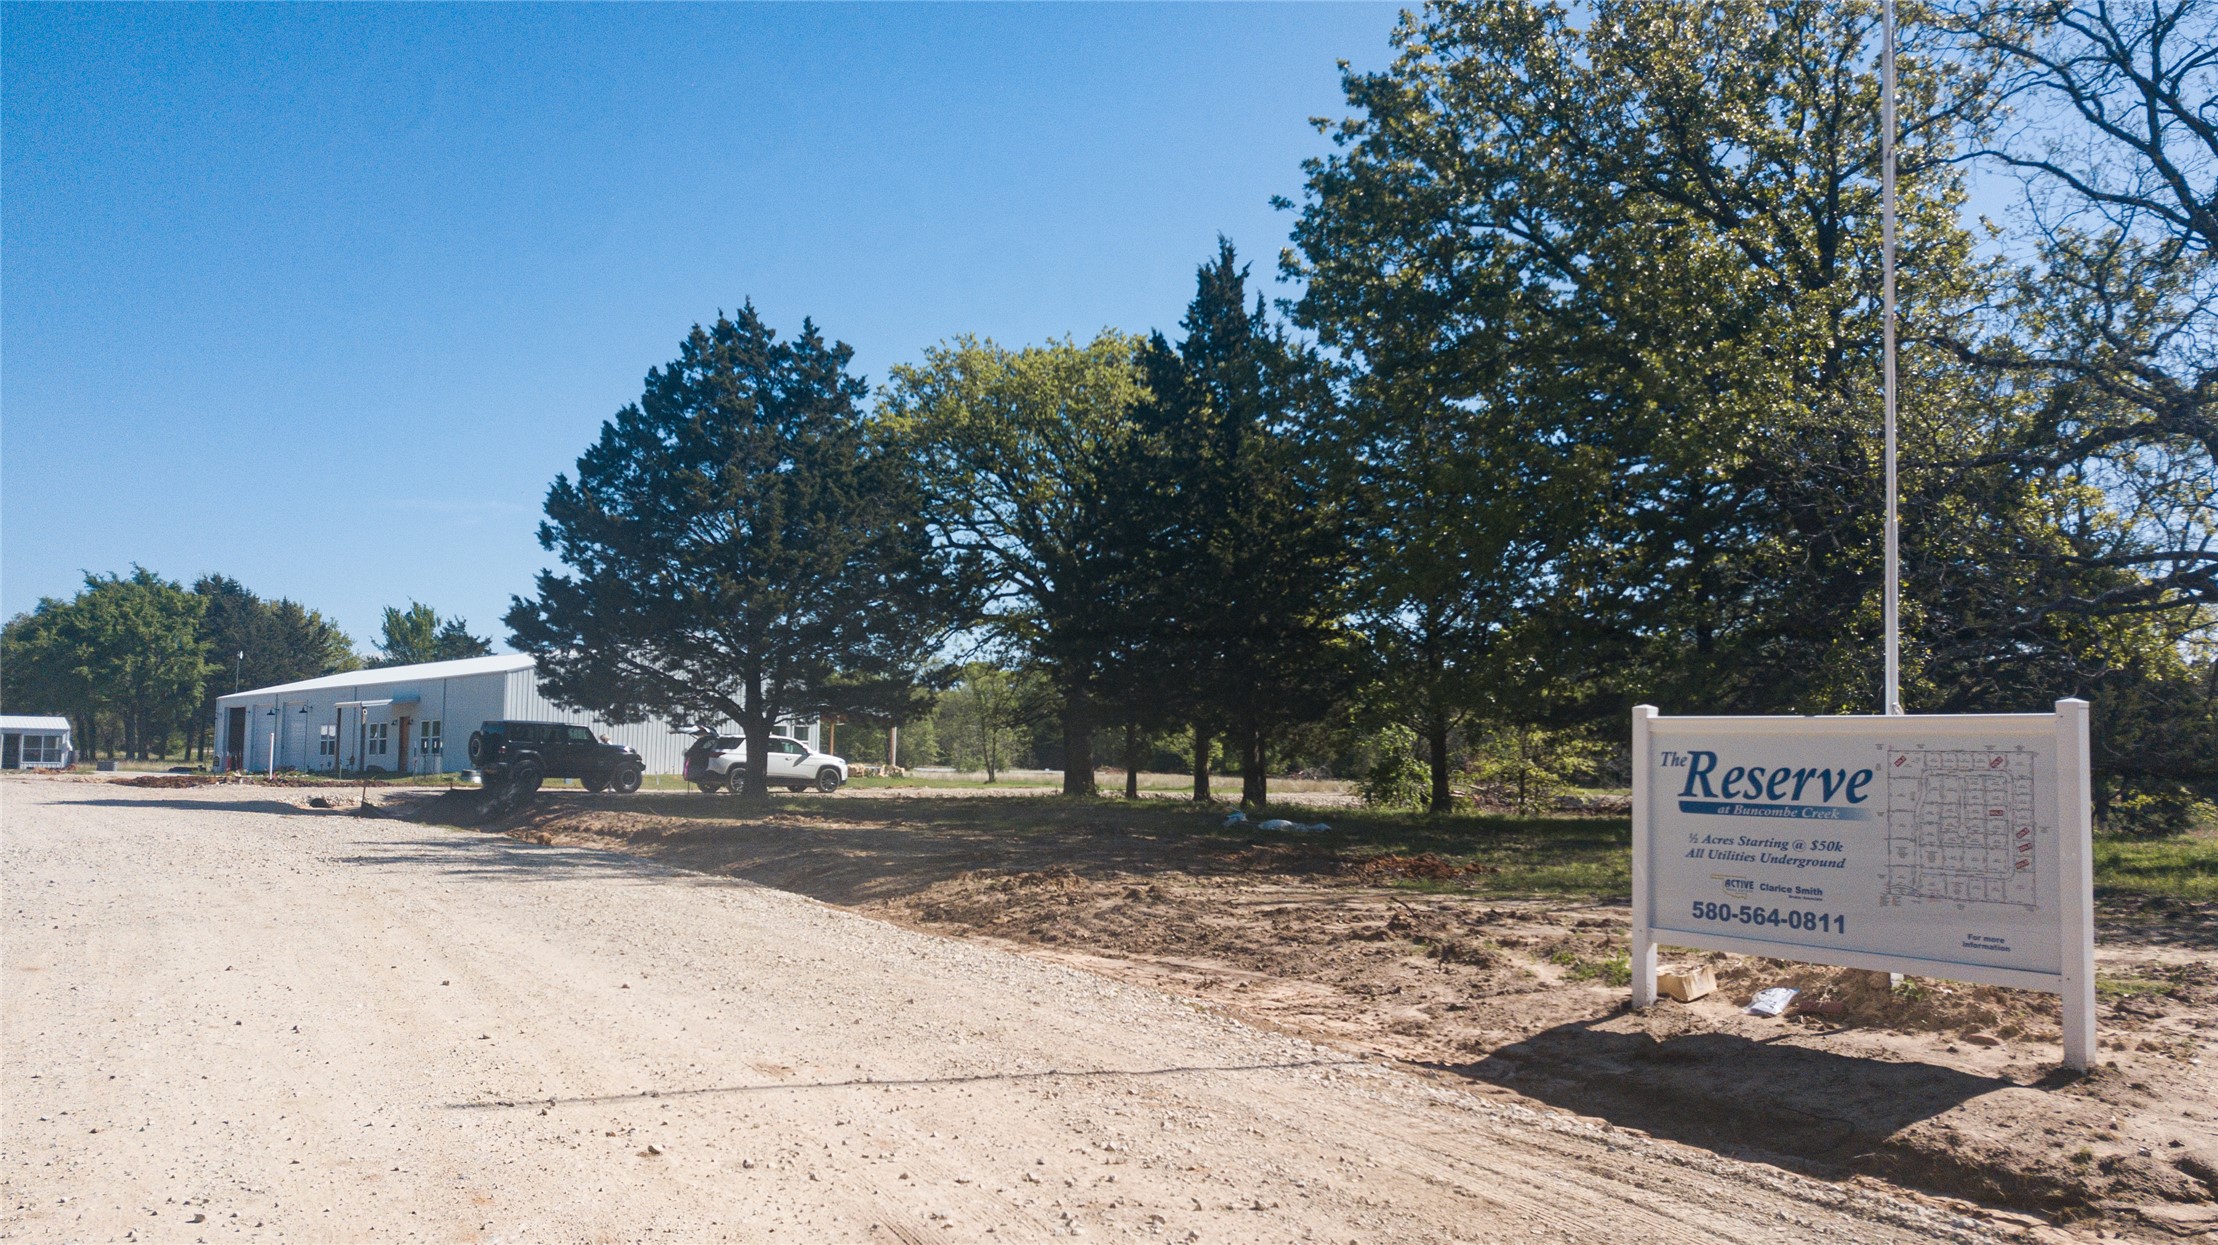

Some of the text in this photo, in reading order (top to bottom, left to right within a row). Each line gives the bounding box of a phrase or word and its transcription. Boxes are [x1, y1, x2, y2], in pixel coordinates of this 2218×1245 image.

[1660, 750, 1873, 804] The Reserve
[1717, 804, 1840, 819] at Buncombe Creek
[1702, 834, 1735, 846] Acres
[1737, 836, 1789, 851] Starting
[1792, 839, 1807, 852] @
[1810, 839, 1844, 853] $50k
[1685, 848, 1847, 869] All Utilities Underground
[1724, 878, 1755, 890] ACTIVE
[1759, 882, 1793, 894] Clarice
[1795, 885, 1823, 897] Smith
[1692, 901, 1846, 934] 580-564-0811
[1967, 933, 2005, 944] For more
